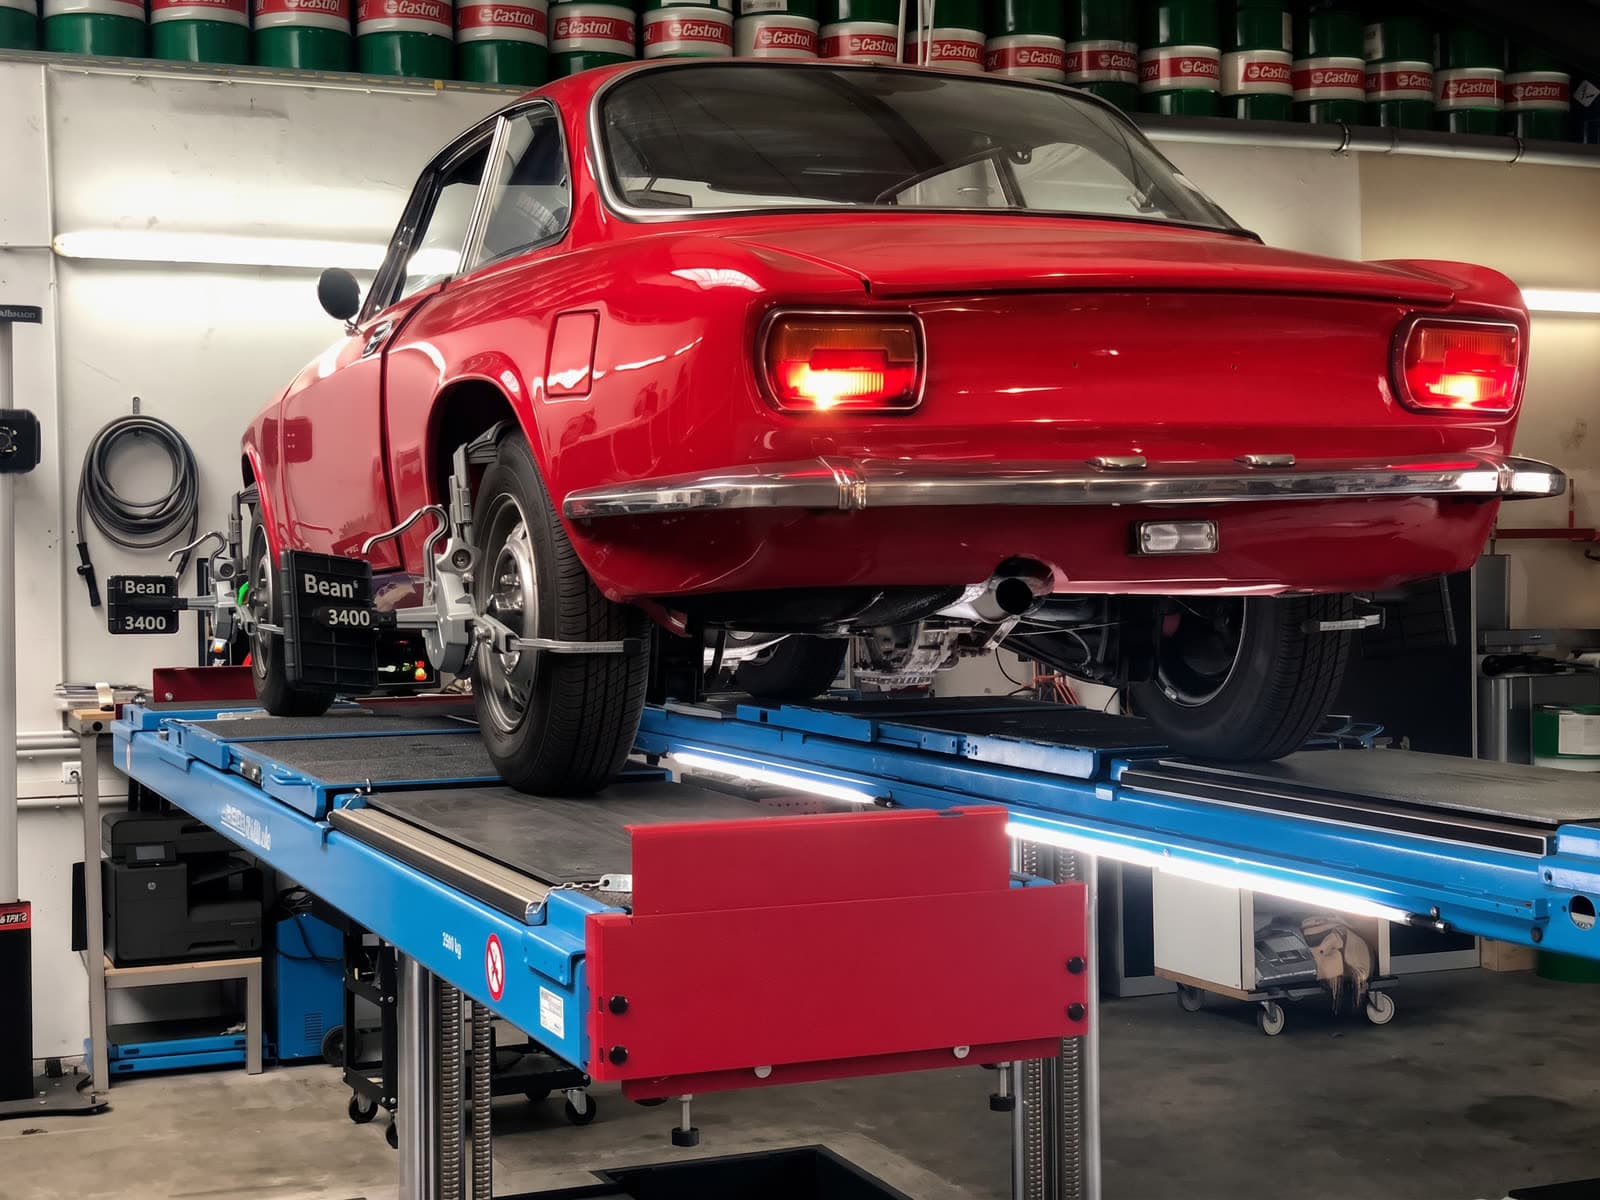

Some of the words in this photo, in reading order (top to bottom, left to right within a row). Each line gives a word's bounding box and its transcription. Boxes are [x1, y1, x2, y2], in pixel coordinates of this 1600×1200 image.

[399, 0, 439, 18] Castrol
[493, 8, 535, 25] Castrol
[569, 21, 611, 35] Castrol
[683, 24, 723, 39] Castrol
[772, 31, 811, 47] Castrol
[942, 44, 979, 58] Castrol
[1324, 71, 1359, 84] Castrol
[1459, 81, 1495, 95] Castrol
[1525, 85, 1560, 97] Castrol
[125, 580, 166, 594] Bean
[304, 573, 354, 599] Bean
[125, 616, 166, 630] 3400
[328, 609, 370, 626] 3400
